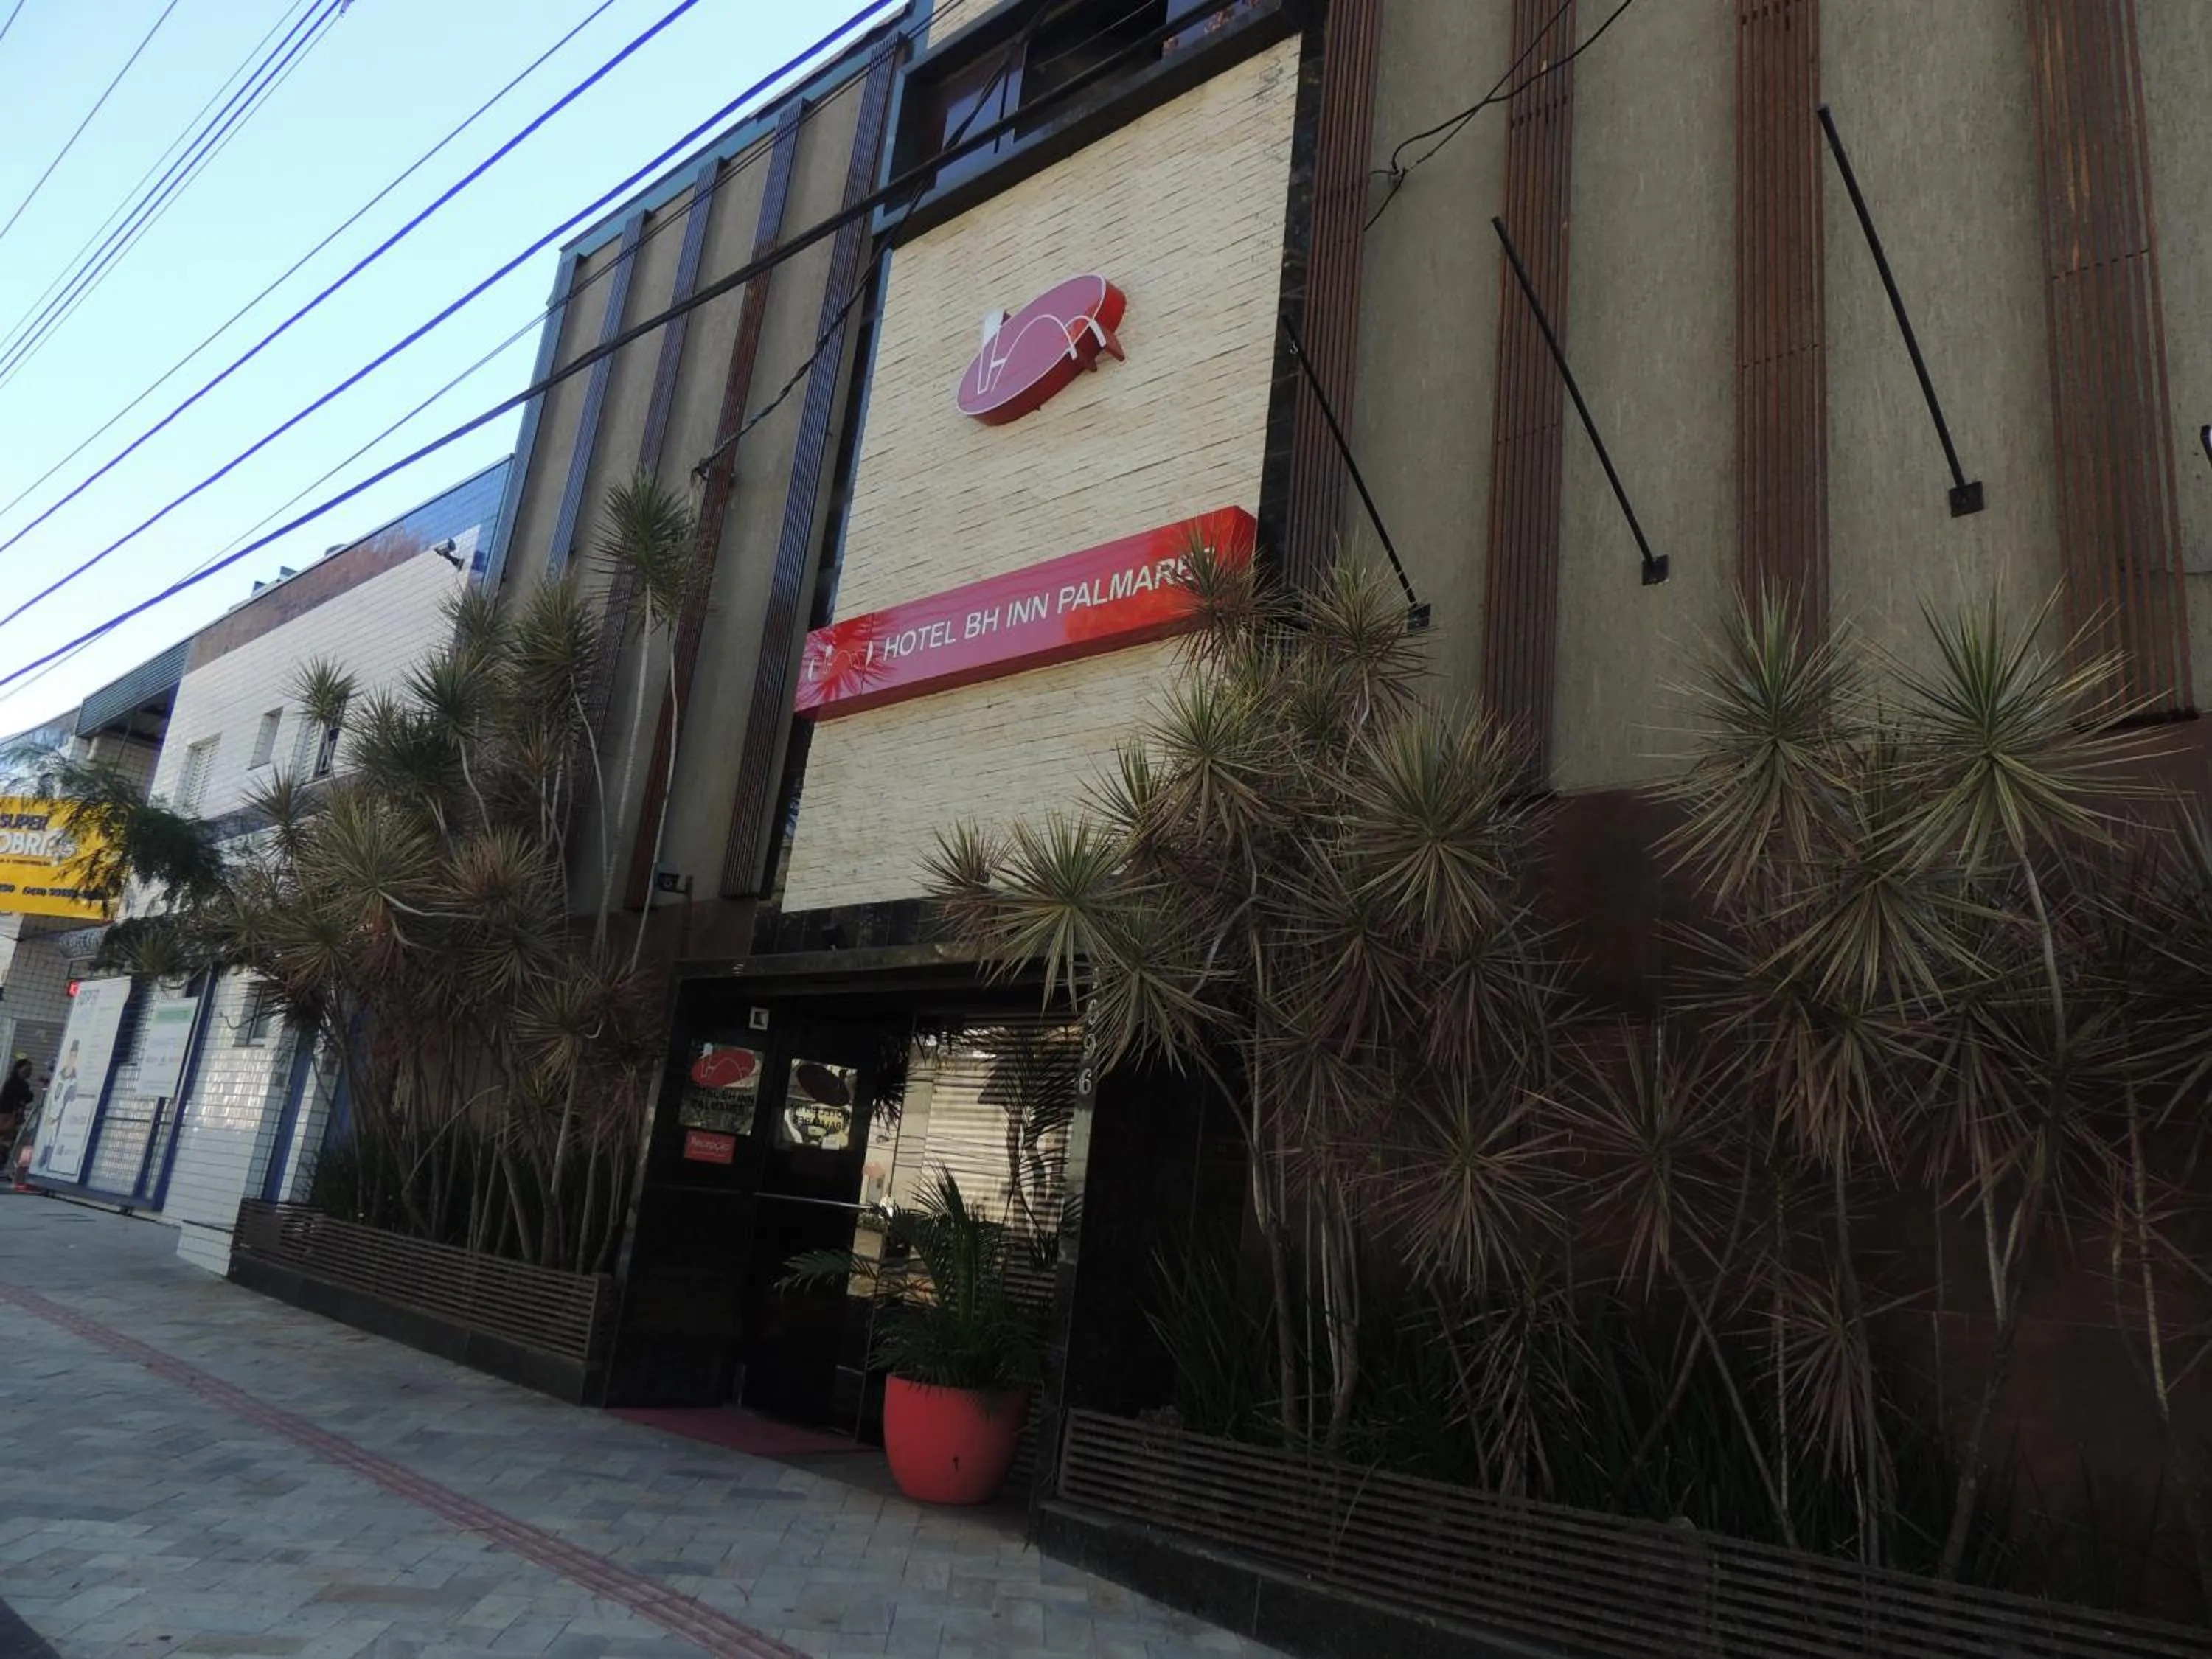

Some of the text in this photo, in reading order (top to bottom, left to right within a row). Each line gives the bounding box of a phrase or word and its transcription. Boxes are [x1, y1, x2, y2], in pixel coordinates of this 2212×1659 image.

[883, 620, 956, 661] HOTEL
[964, 605, 1000, 639] BH
[1006, 592, 1049, 628] INN
[0, 813, 49, 832] SUPER
